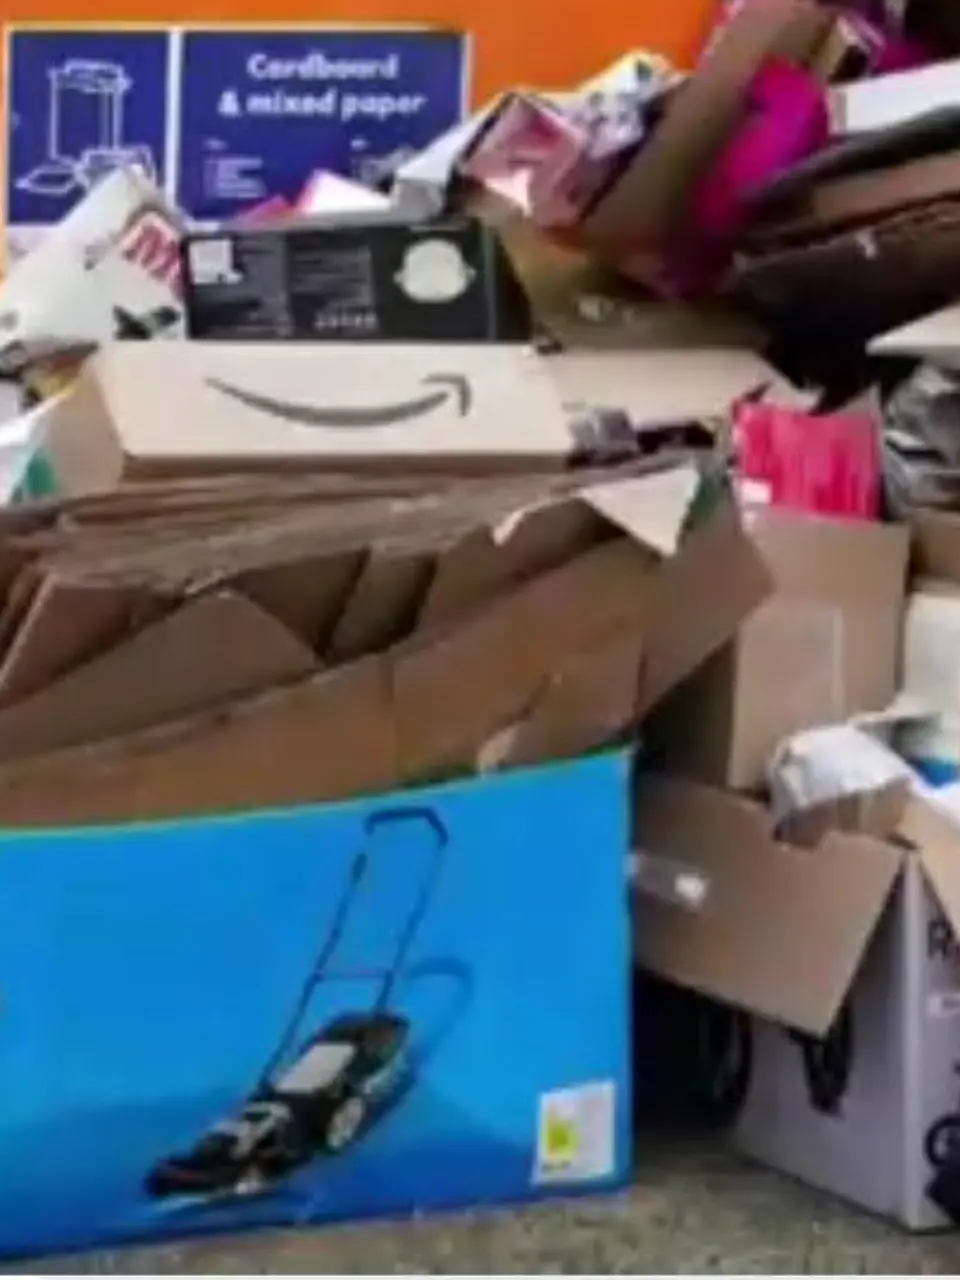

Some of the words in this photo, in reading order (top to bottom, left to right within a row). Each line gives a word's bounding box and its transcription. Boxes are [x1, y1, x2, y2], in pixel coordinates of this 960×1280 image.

[247, 51, 399, 81] Cardboard
[218, 88, 240, 117] &
[247, 87, 337, 115] mixed
[342, 94, 427, 122] paper
